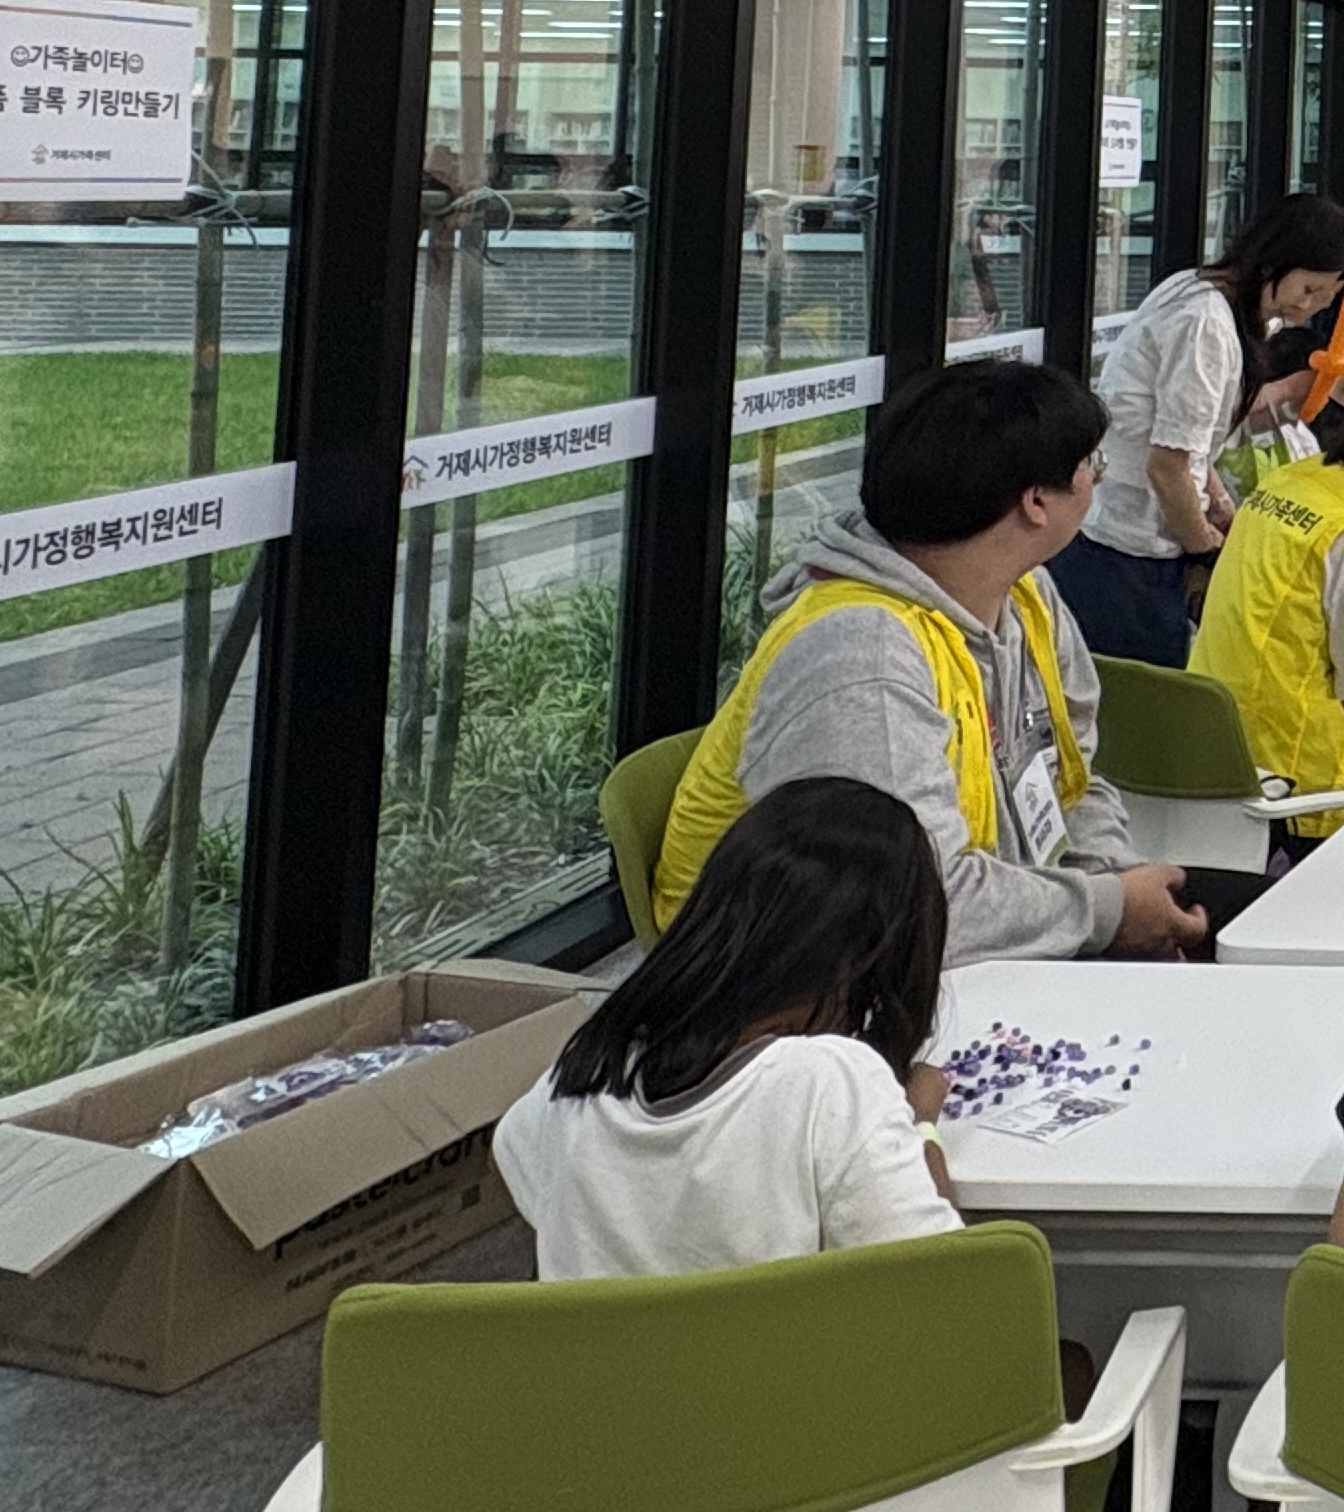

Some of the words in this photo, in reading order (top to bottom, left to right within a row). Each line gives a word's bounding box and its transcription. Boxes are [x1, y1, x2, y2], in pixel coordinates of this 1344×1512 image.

[30, 44, 128, 75] 가족놀이터
[19, 85, 67, 116] 블록
[77, 87, 181, 120] 키링만들기
[739, 373, 857, 418] 거제시가정행복지원센터
[435, 421, 612, 482] 거제시가정행복지원센터
